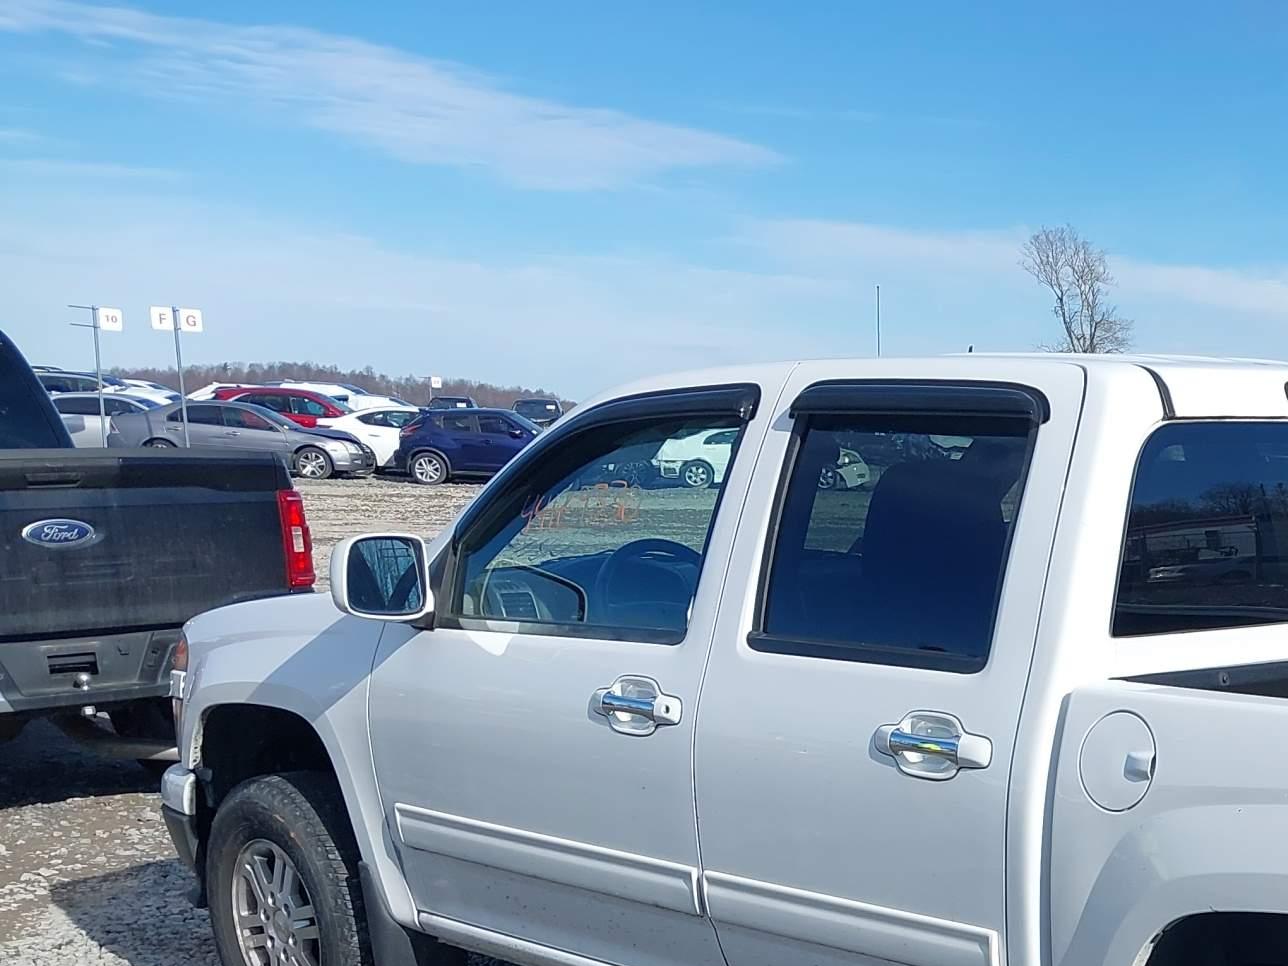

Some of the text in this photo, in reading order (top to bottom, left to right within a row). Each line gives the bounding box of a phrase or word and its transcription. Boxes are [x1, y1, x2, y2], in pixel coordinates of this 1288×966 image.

[104, 314, 118, 323] 10
[158, 313, 166, 324] F
[185, 315, 197, 327] G
[41, 525, 79, 541] Ford
